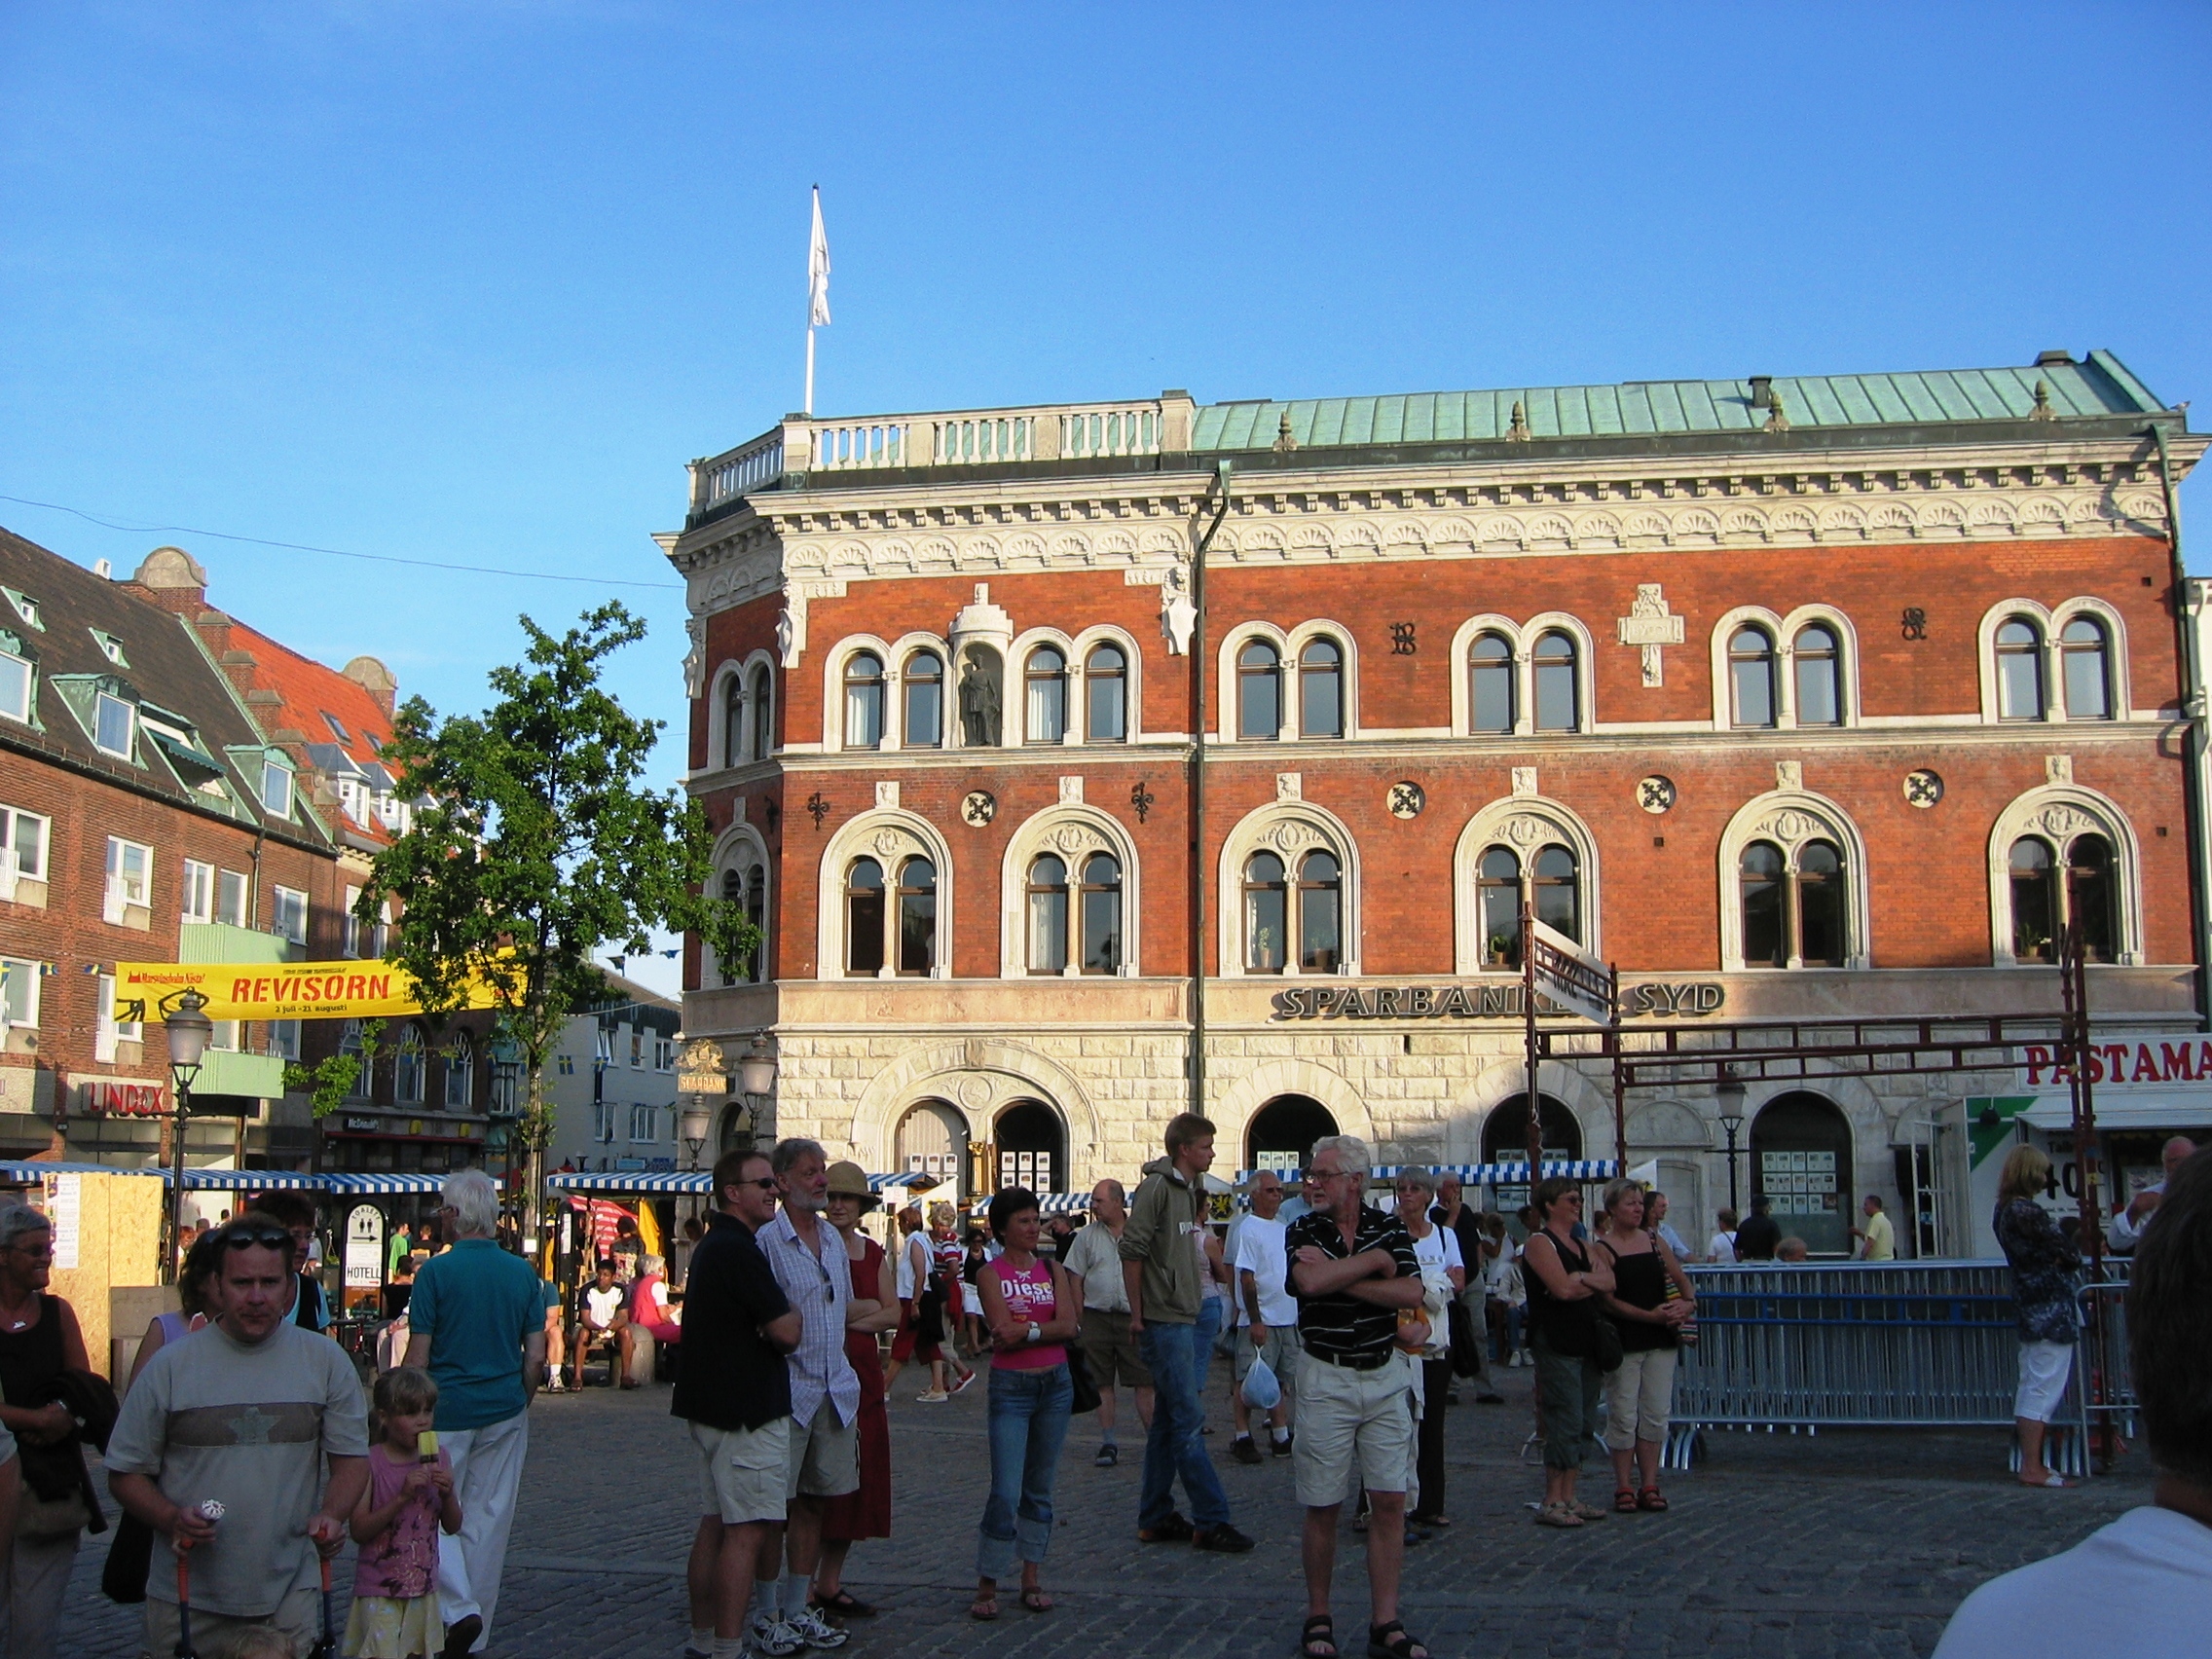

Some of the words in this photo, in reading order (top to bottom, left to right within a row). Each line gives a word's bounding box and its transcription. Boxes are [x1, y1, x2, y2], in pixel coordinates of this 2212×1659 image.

[232, 975, 390, 1003] REVISORN
[1635, 982, 1725, 1014] SYD
[315, 1004, 347, 1013] augusti
[347, 1266, 381, 1279] HOTELL
